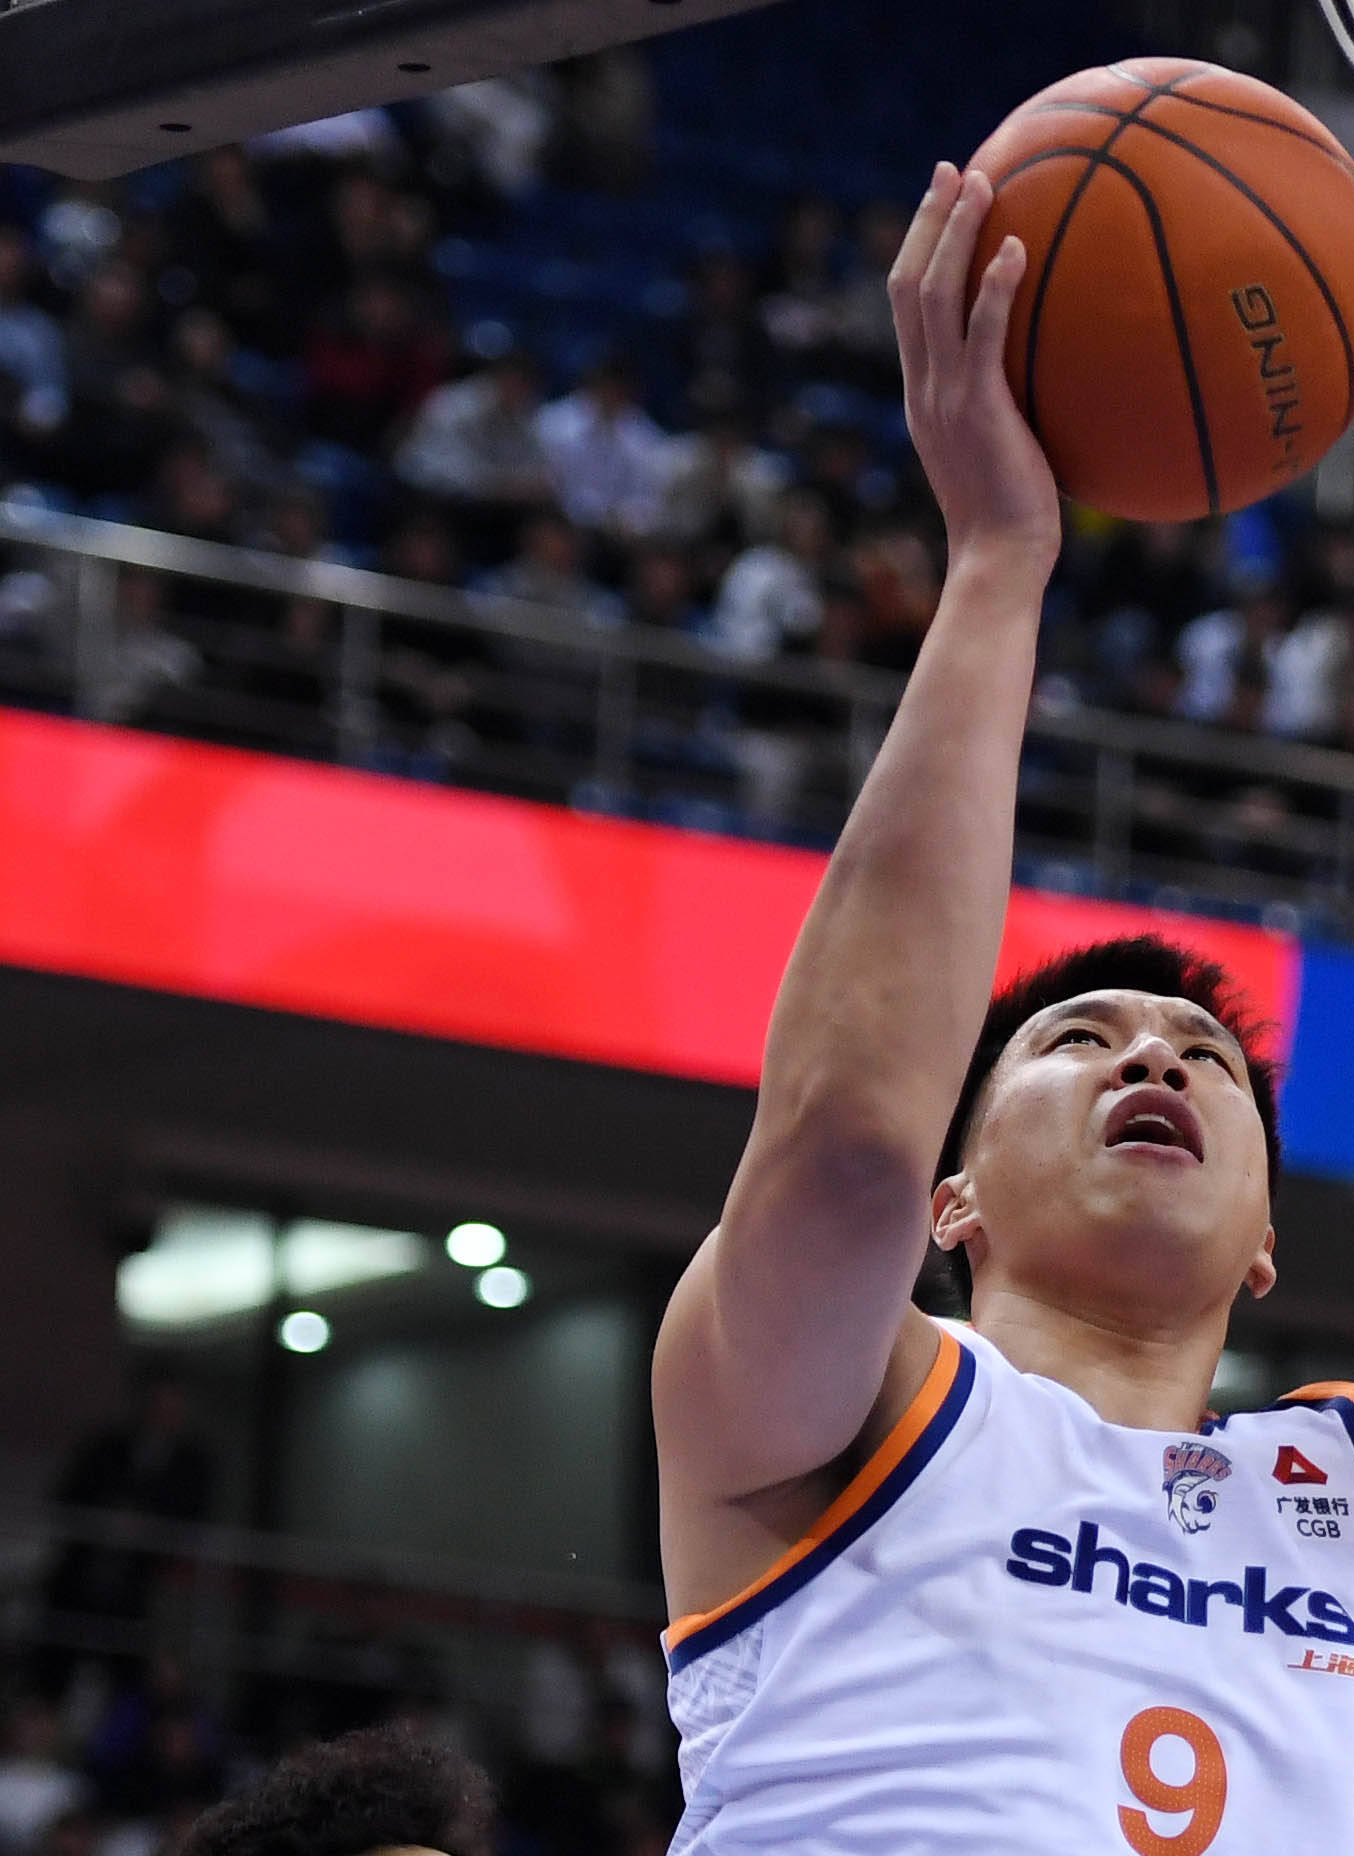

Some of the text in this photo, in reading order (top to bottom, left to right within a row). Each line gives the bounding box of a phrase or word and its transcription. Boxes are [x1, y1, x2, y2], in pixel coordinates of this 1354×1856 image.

[1277, 1496, 1349, 1517] 广发银行
[1297, 1519, 1341, 1539] CGB
